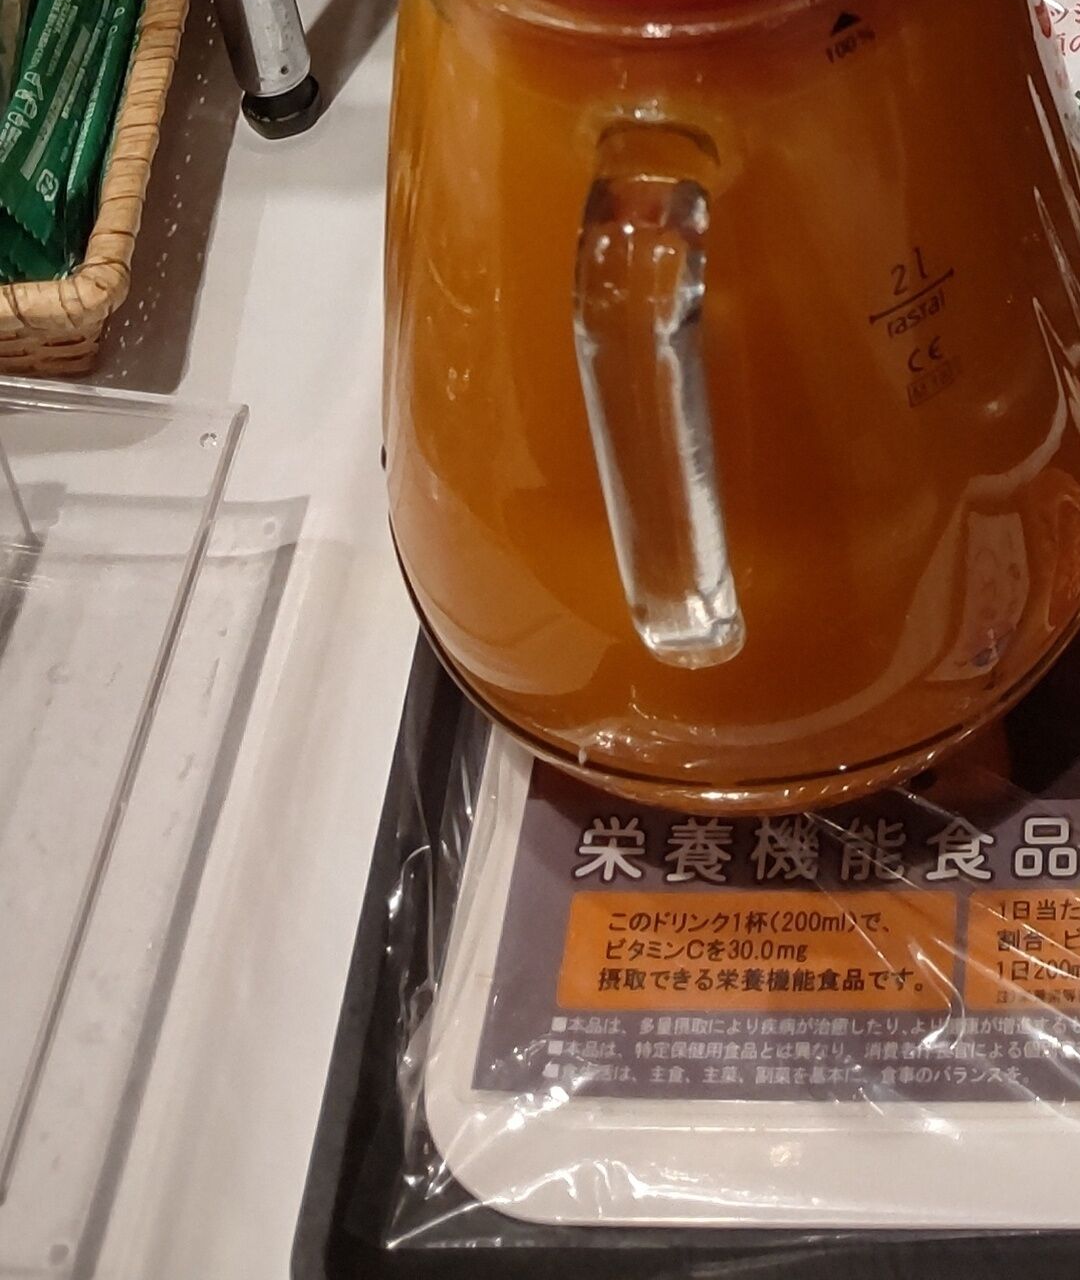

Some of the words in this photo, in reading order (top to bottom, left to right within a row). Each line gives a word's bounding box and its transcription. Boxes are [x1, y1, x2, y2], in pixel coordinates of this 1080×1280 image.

[575, 816, 1080, 881] 栄養機能食品
[597, 967, 924, 992] 摂取できる栄養機能食品です。
